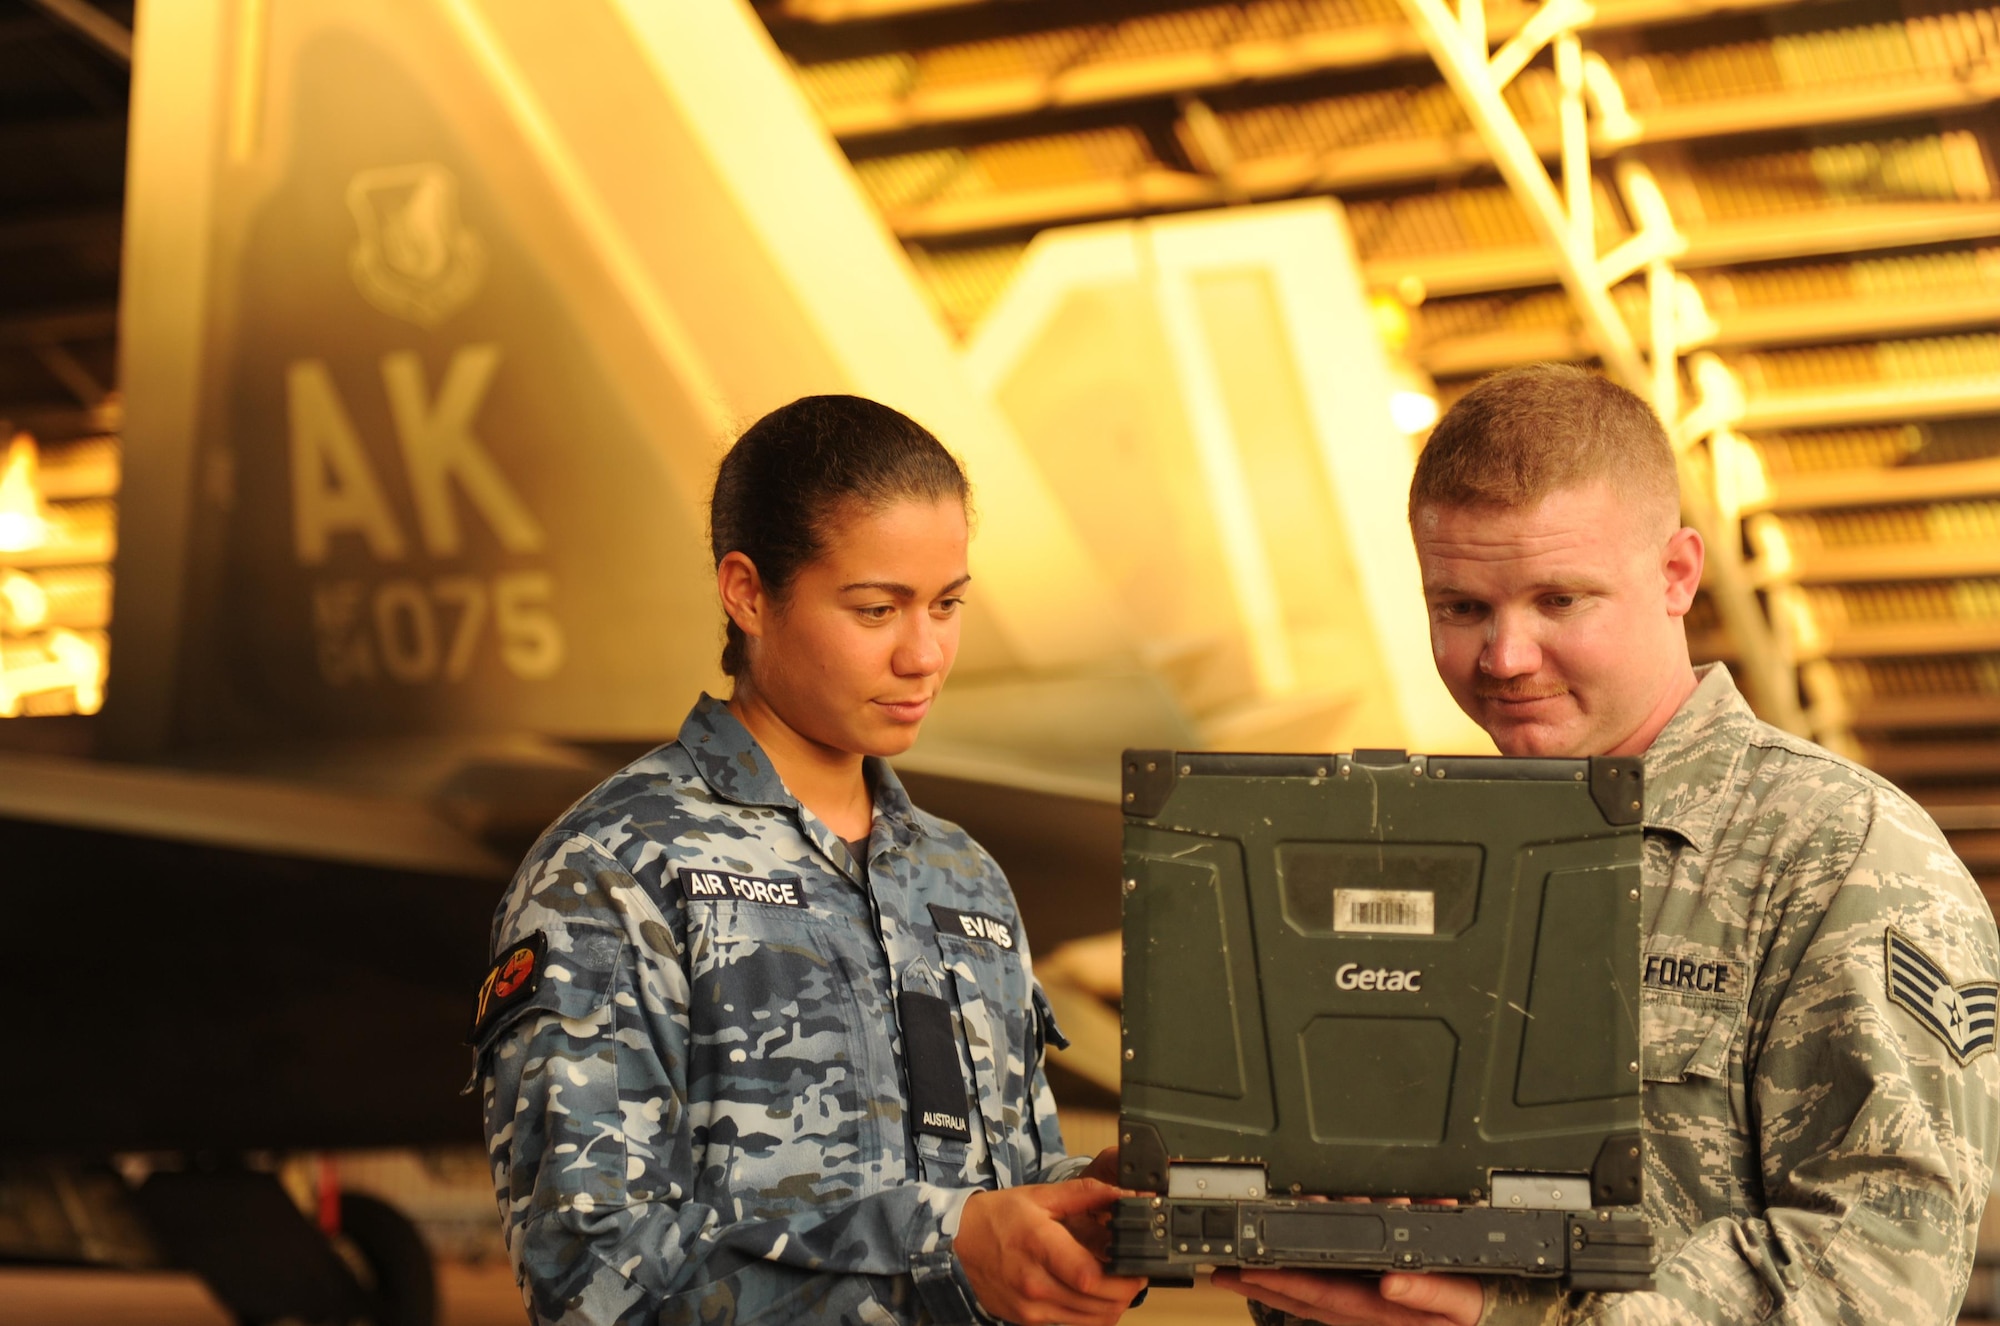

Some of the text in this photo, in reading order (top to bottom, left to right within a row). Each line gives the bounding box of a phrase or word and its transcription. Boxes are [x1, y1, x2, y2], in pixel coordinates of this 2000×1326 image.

[286, 343, 545, 564] AK
[373, 574, 566, 685] 075
[691, 872, 799, 905] AIR FORCE
[958, 914, 1013, 949] EVANS
[1335, 963, 1421, 992] Getac
[1643, 955, 1730, 993] FORCE
[923, 1111, 967, 1131] AUSTRALIA
